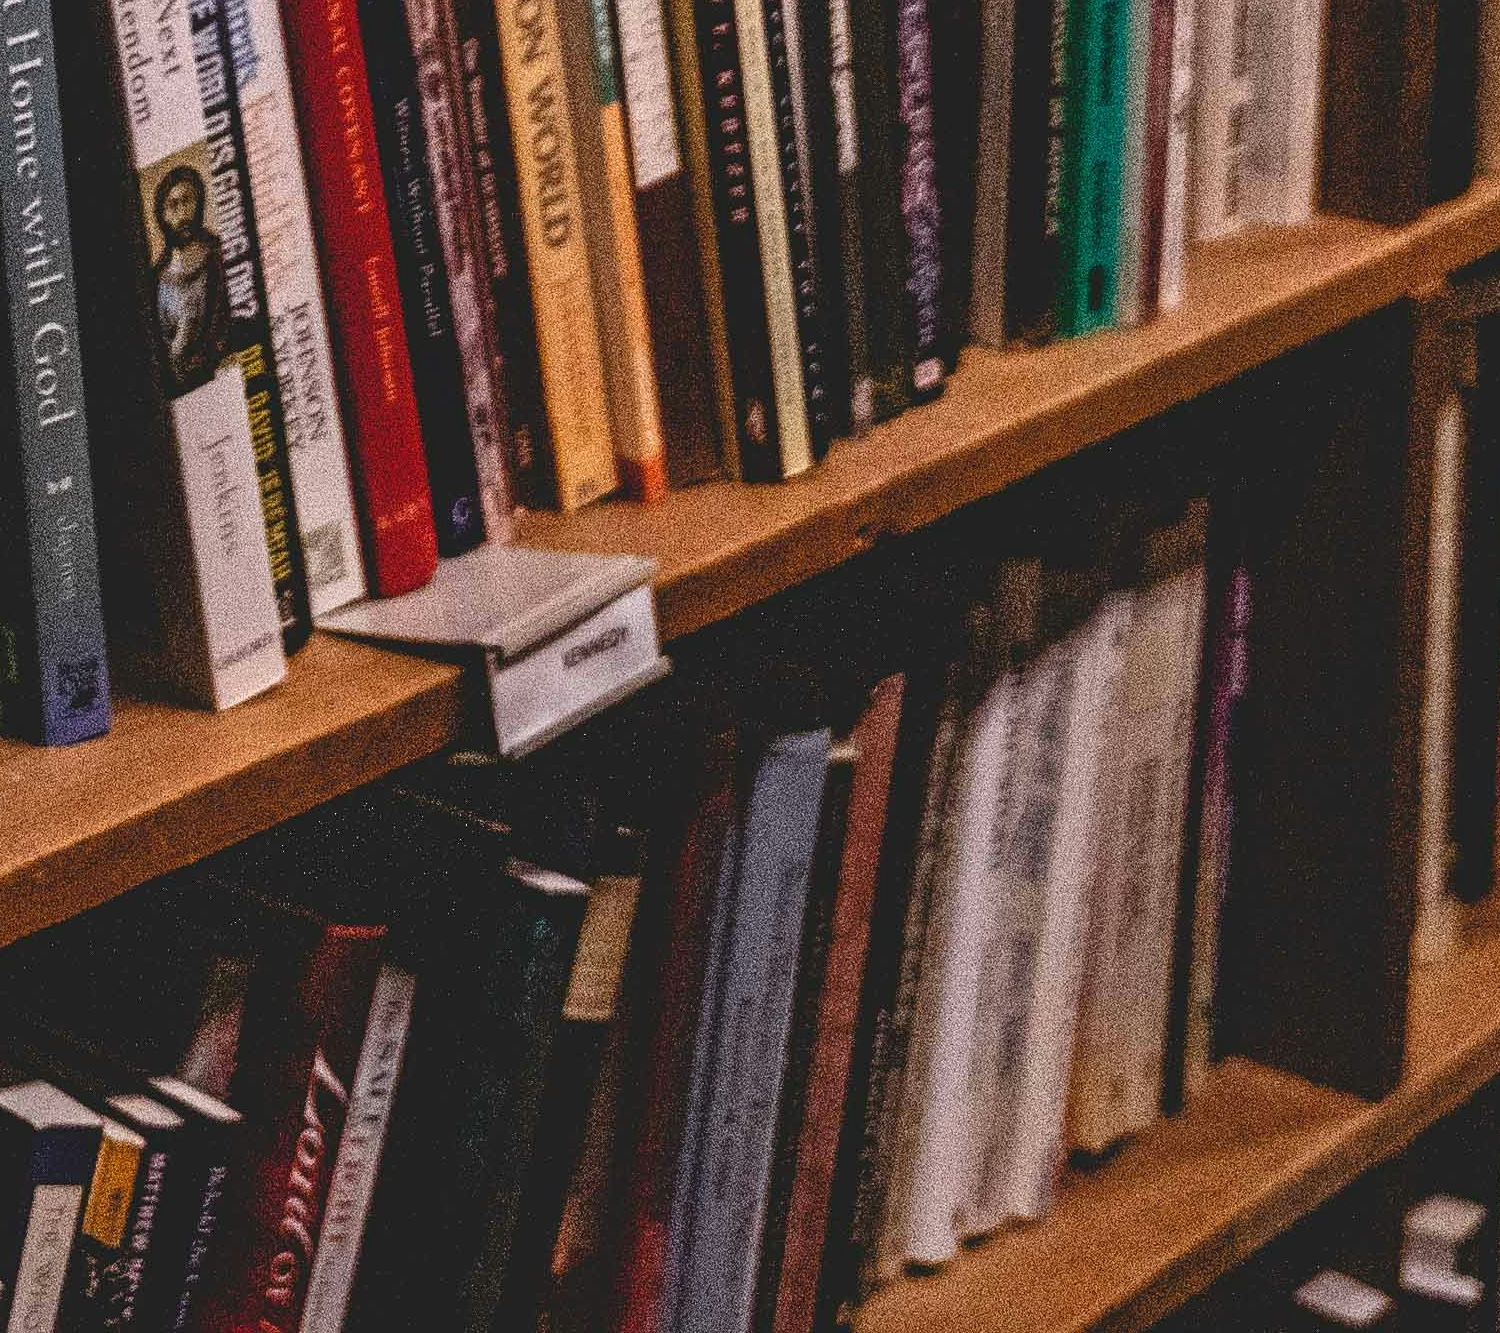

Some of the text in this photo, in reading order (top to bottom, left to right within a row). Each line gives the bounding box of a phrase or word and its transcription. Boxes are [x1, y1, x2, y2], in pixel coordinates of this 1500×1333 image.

[6, 29, 44, 178] Home
[19, 196, 67, 305] with
[31, 323, 75, 427] God
